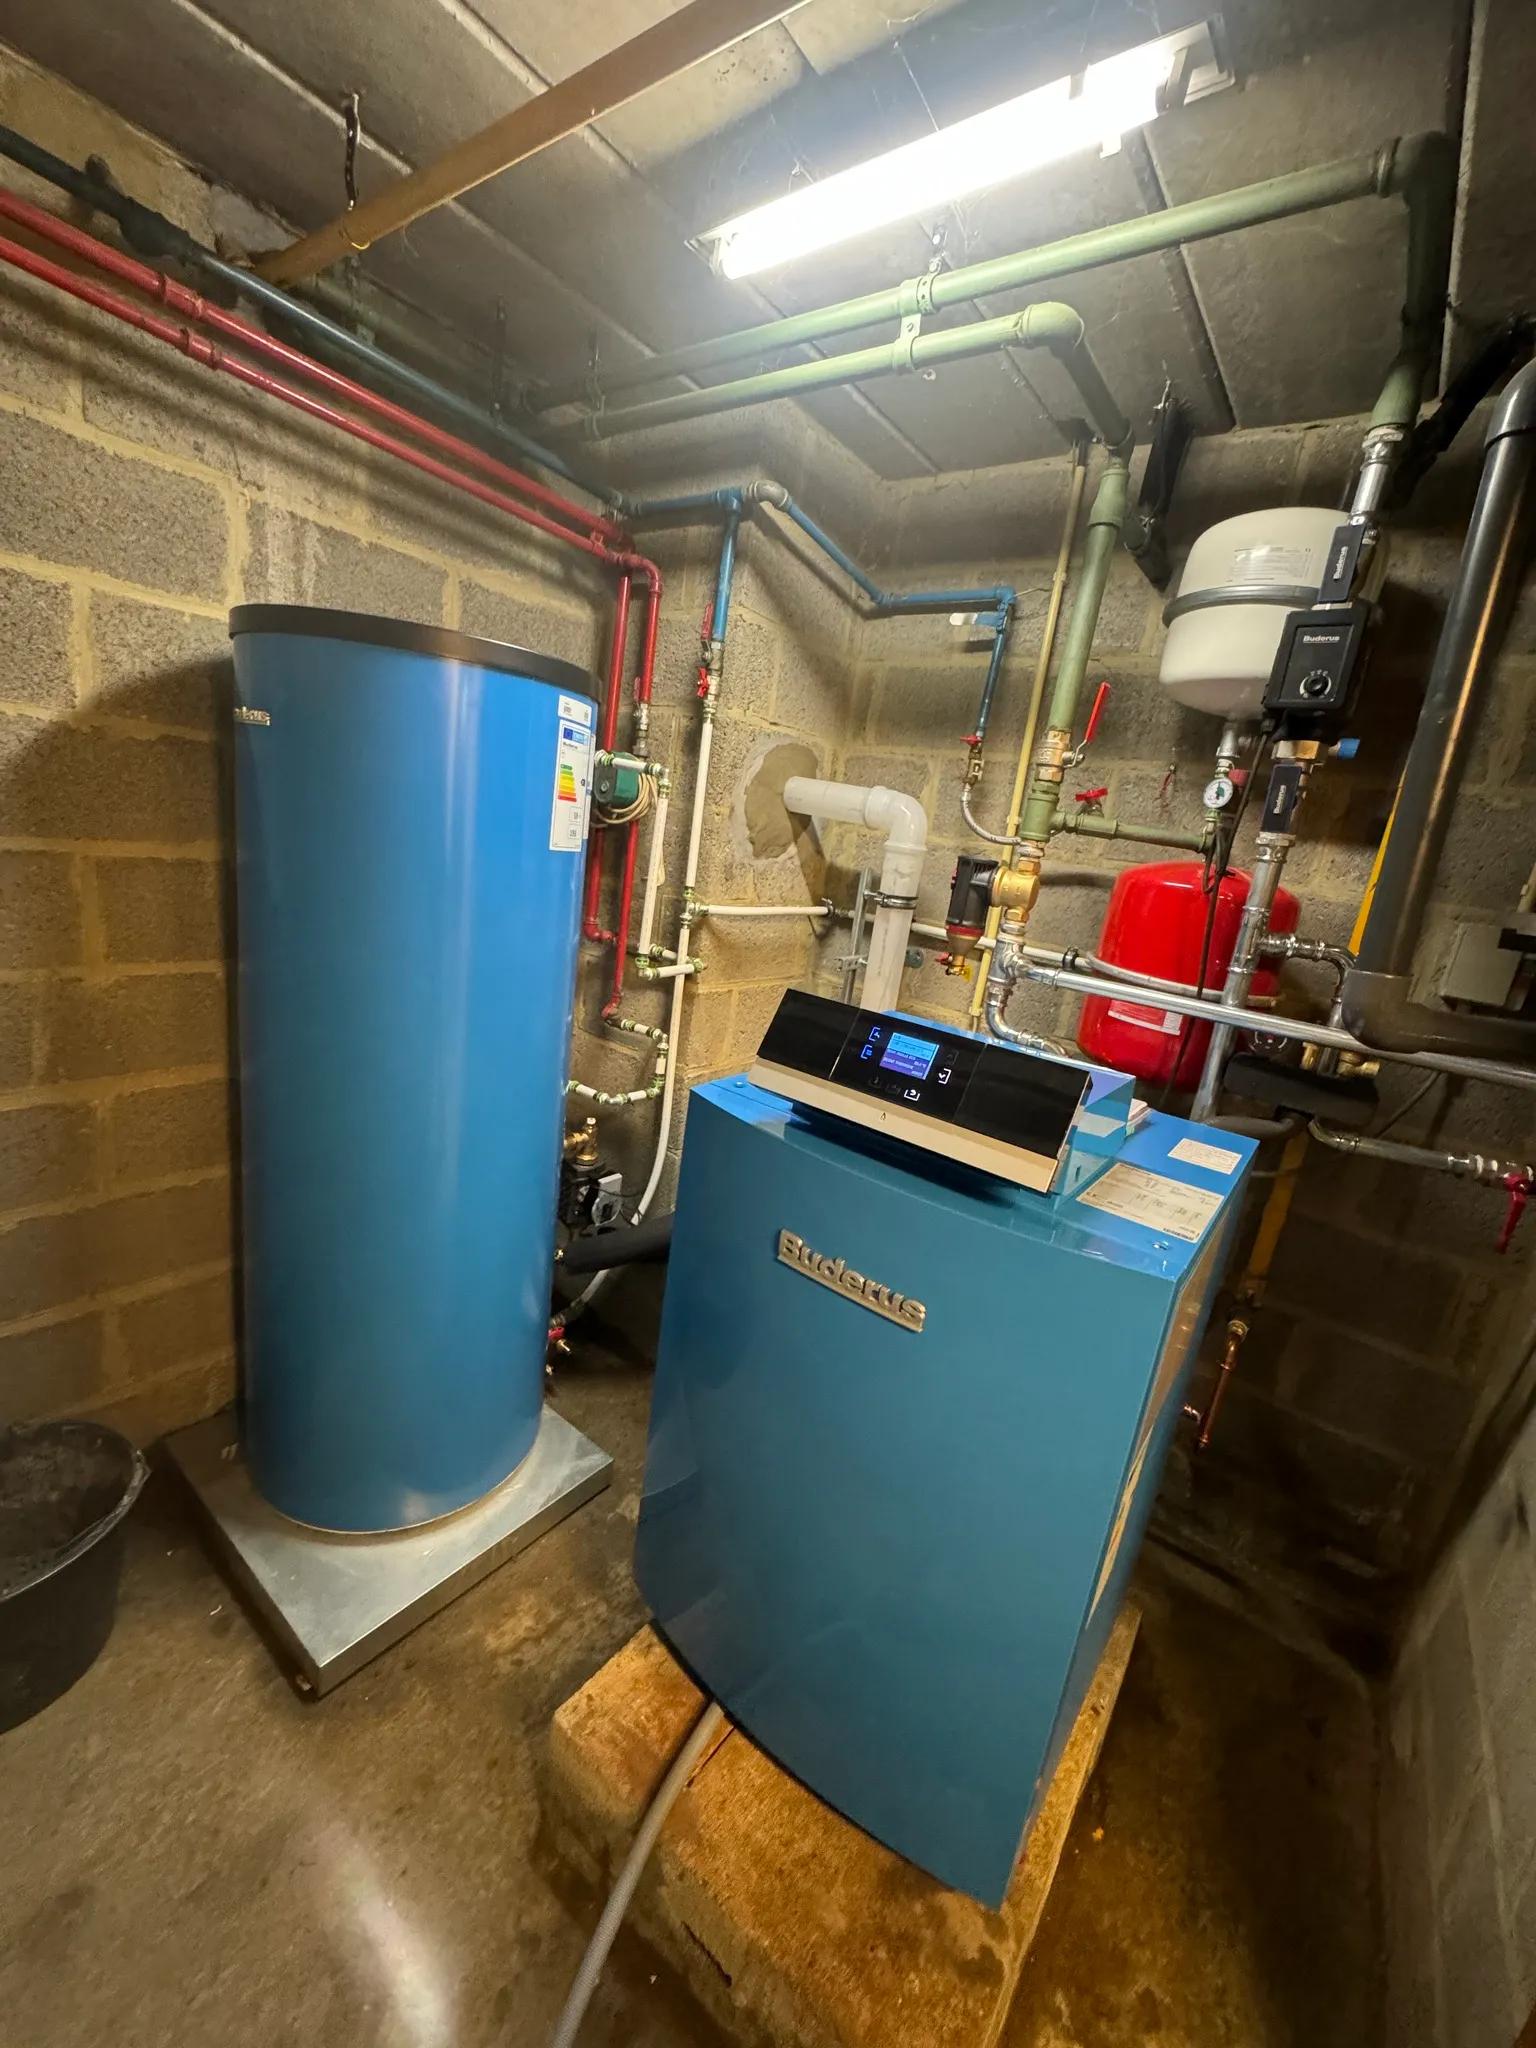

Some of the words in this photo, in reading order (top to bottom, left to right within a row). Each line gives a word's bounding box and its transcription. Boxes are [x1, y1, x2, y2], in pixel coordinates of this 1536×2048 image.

[1333, 546, 1348, 579] Buderus
[1303, 635, 1340, 643] Buderus
[1273, 785, 1286, 813] Buderus
[778, 1229, 926, 1331] Buderus
